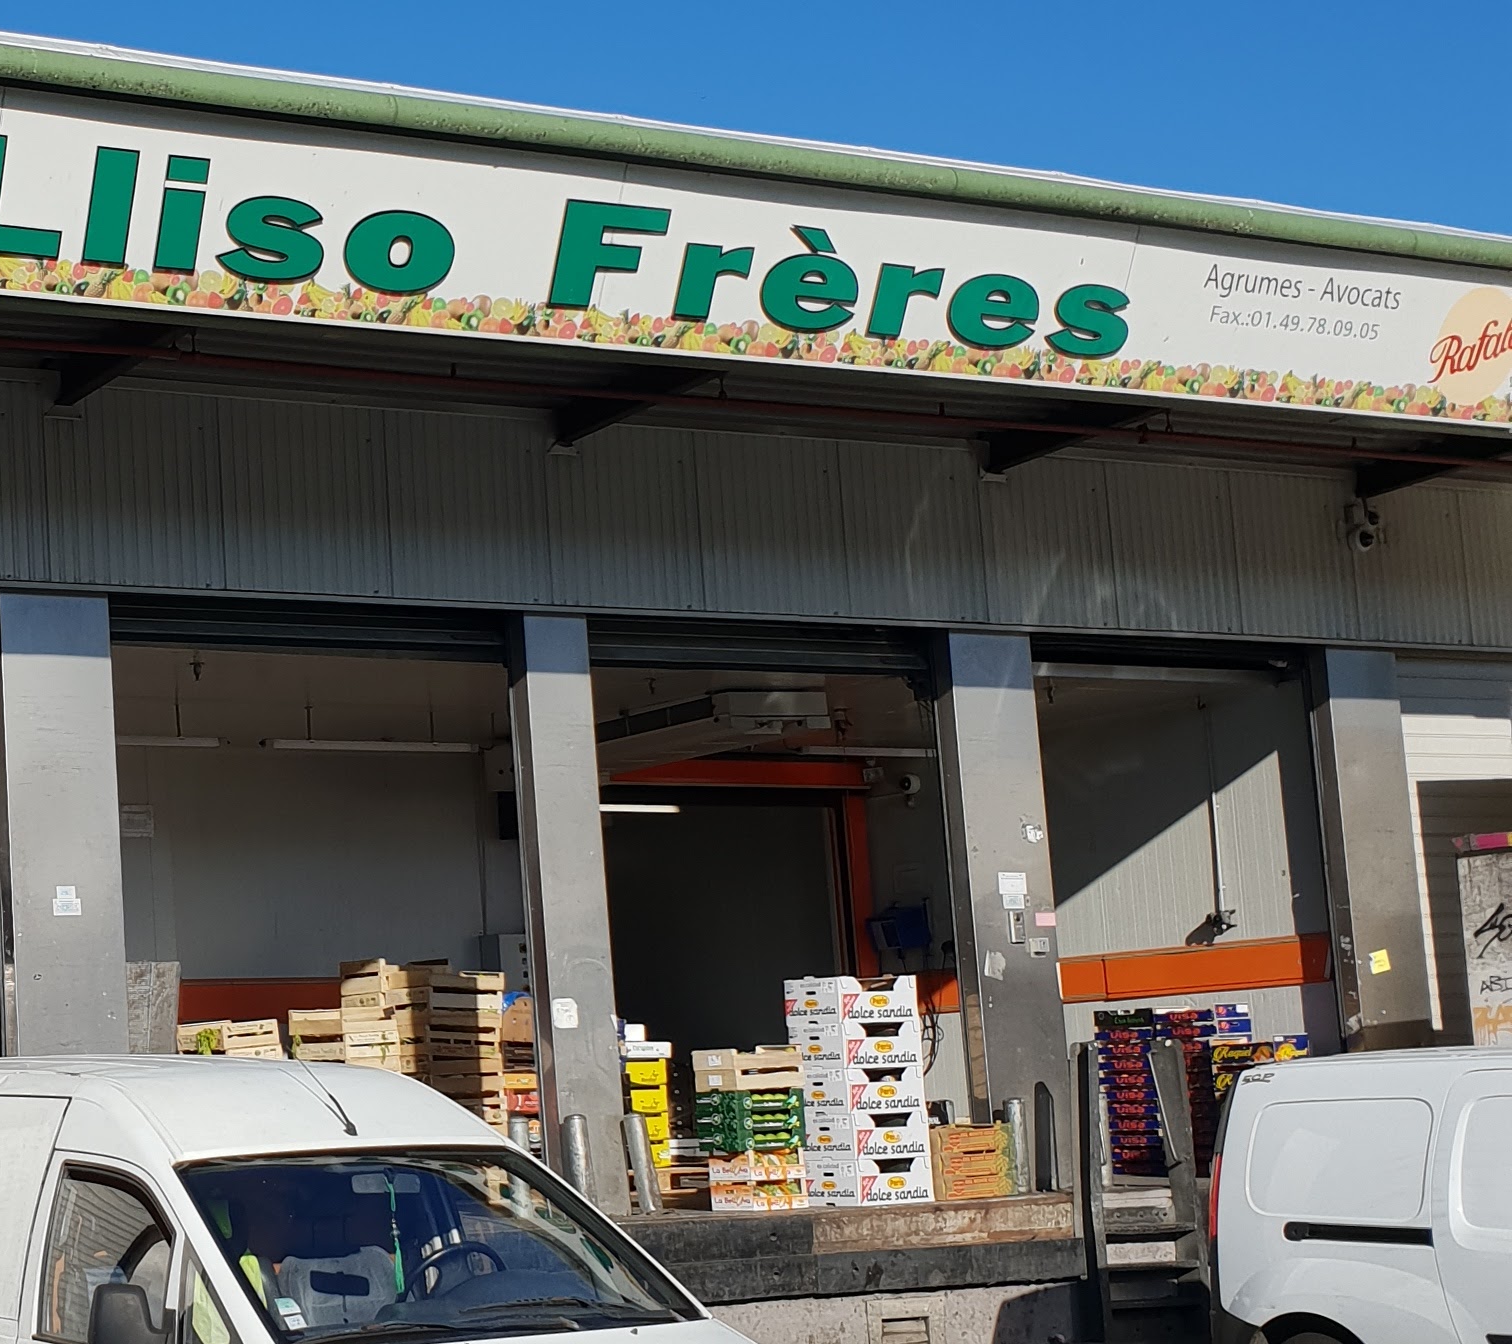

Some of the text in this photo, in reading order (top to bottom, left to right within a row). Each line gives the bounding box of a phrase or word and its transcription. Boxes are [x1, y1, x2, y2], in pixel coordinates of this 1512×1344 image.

[547, 199, 1131, 358] Frères
[1203, 263, 1303, 298] Agrumes
[1320, 277, 1402, 310] Avocats
[1427, 318, 1512, 384] Rafal
[877, 1005, 913, 1018] sandia
[882, 1051, 917, 1064] sandia
[885, 1096, 920, 1108] sandia
[891, 1142, 925, 1154] sandia
[895, 1187, 929, 1200] sandia
